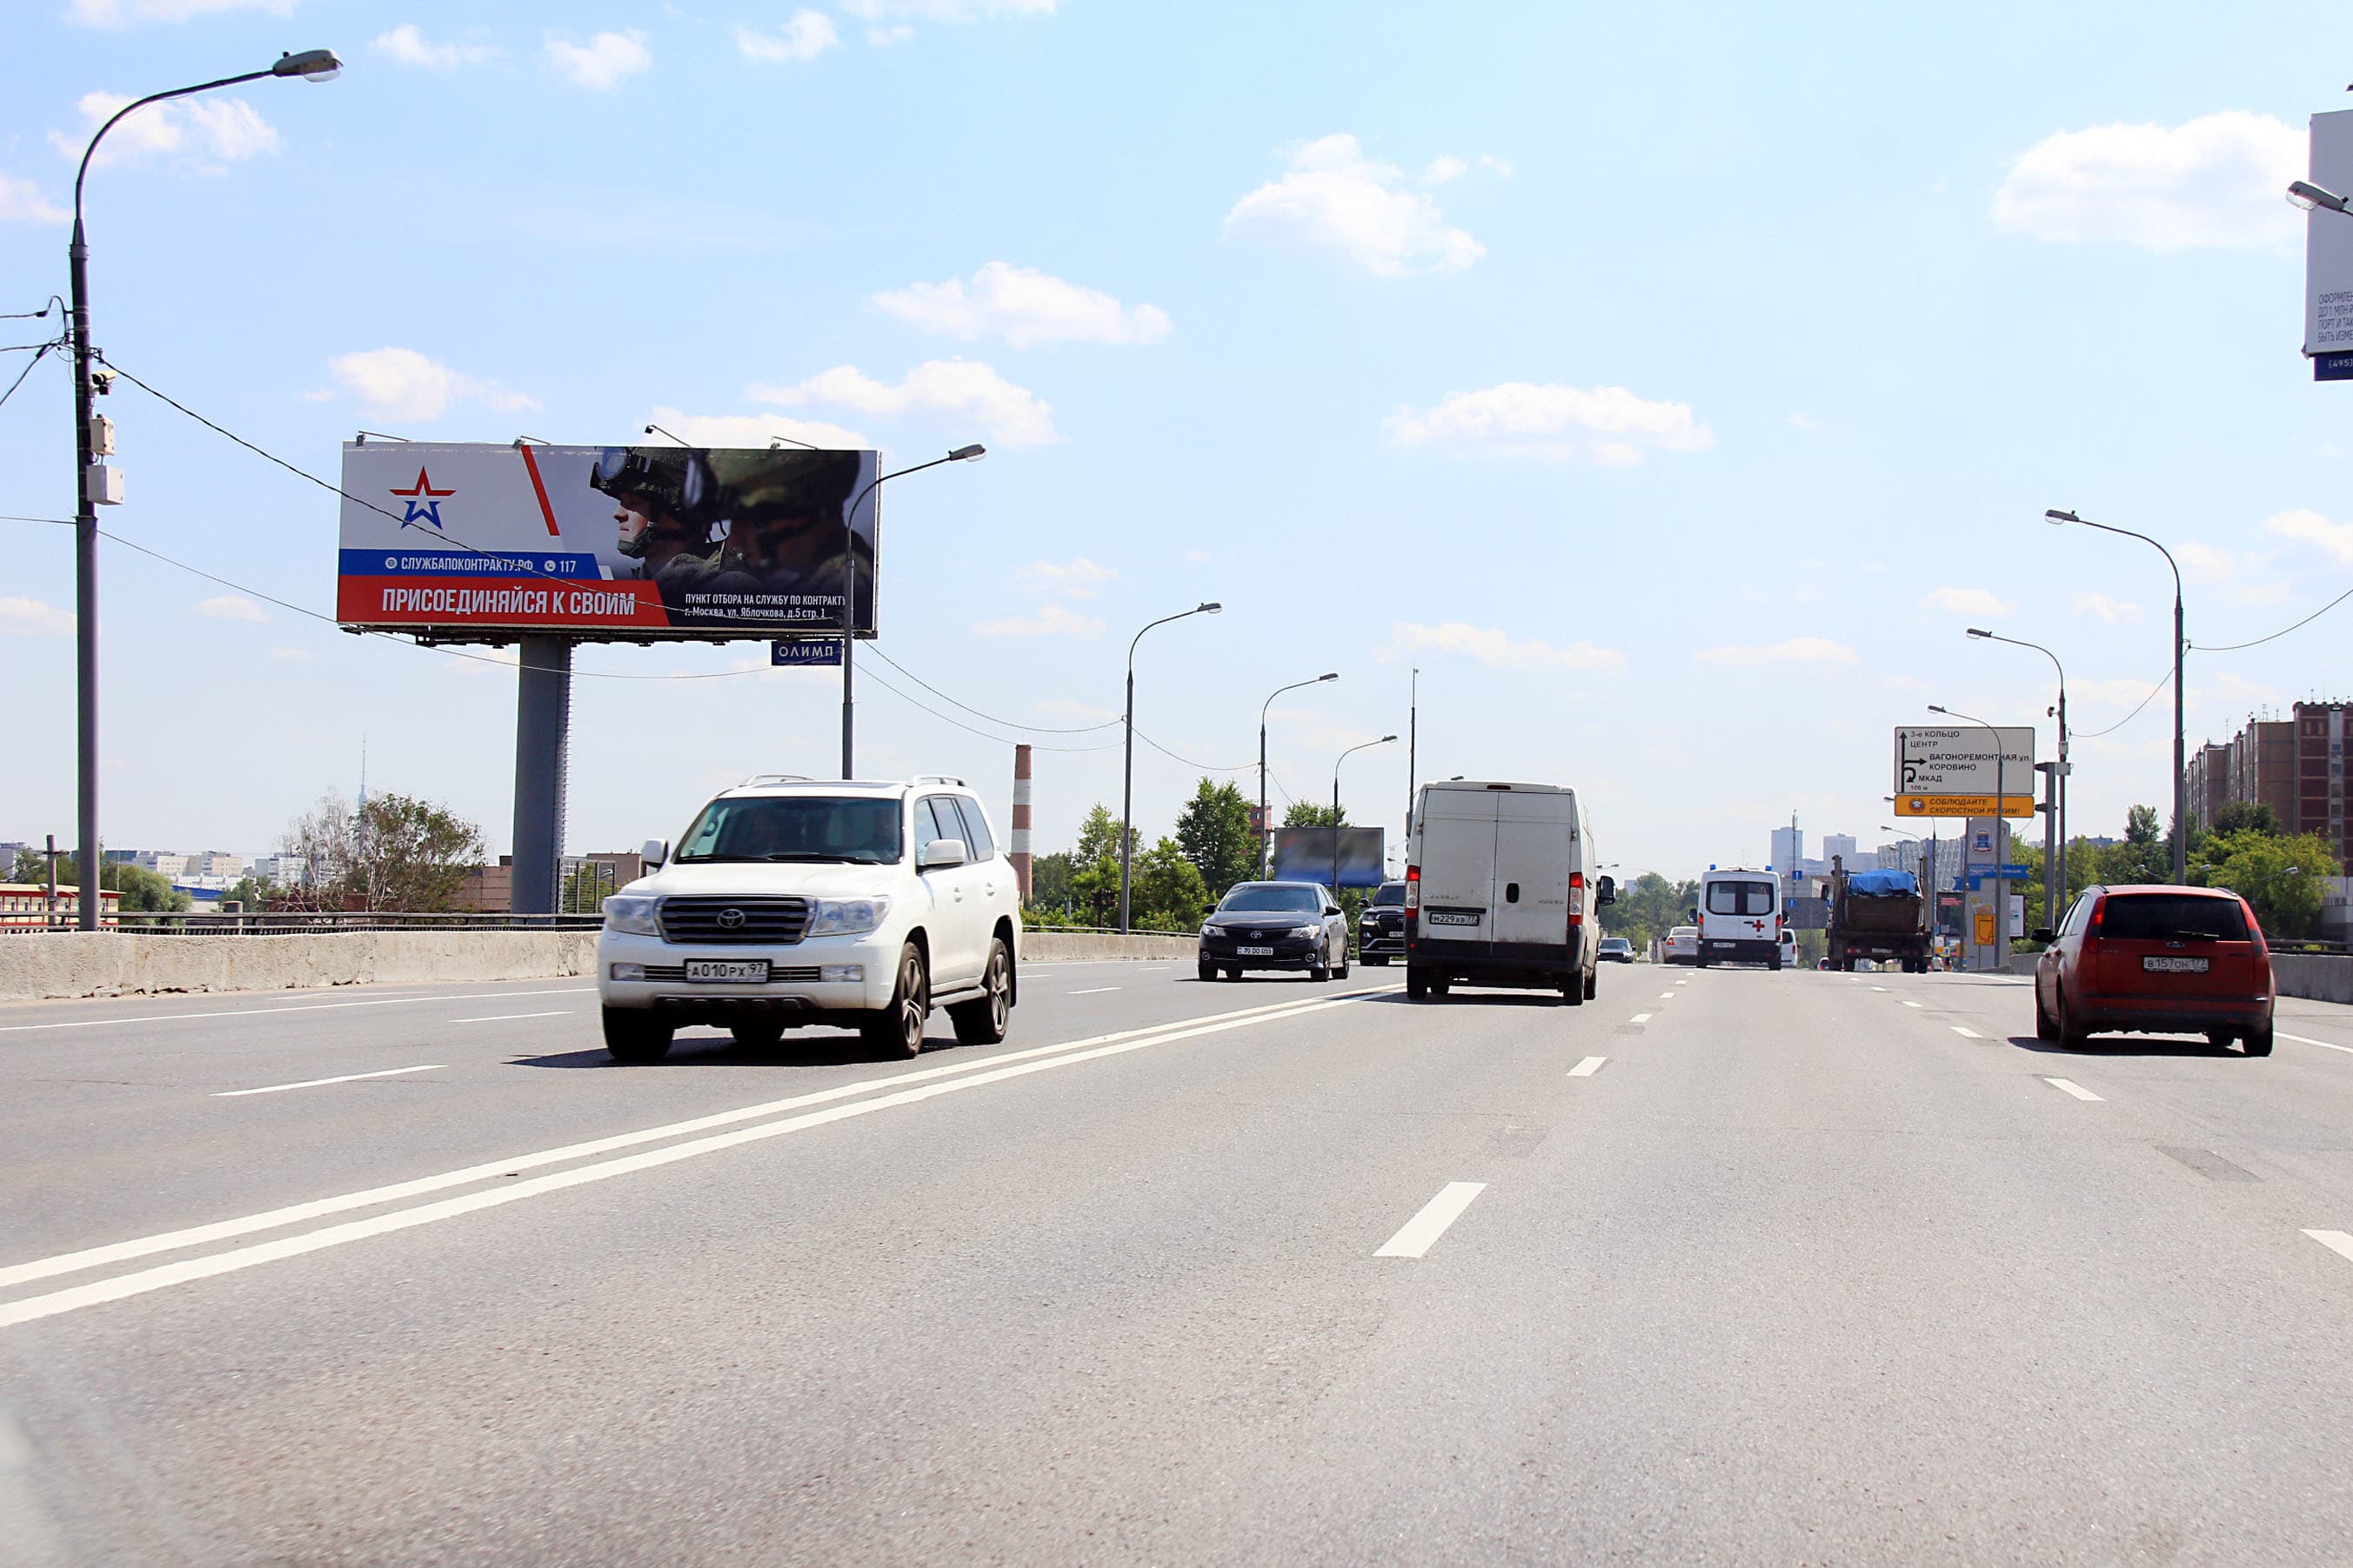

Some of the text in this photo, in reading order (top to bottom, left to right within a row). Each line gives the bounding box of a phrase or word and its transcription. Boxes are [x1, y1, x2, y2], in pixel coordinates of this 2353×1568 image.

[401, 557, 577, 573] СЛУЖБАПОКОНТРАКТУ.РФ 117
[382, 586, 635, 615] ПРИСОЕДИНЯЙСЯ К СВОИМ
[685, 593, 711, 604] ПУНКТ
[712, 594, 742, 604] ОТБОРА
[744, 595, 754, 604] НА
[756, 595, 788, 605] СЛУЖБУ
[790, 596, 800, 605] ПО
[740, 607, 786, 619] Яблочкова,
[820, 608, 826, 618] 1
[779, 646, 832, 657] ОЛИМП
